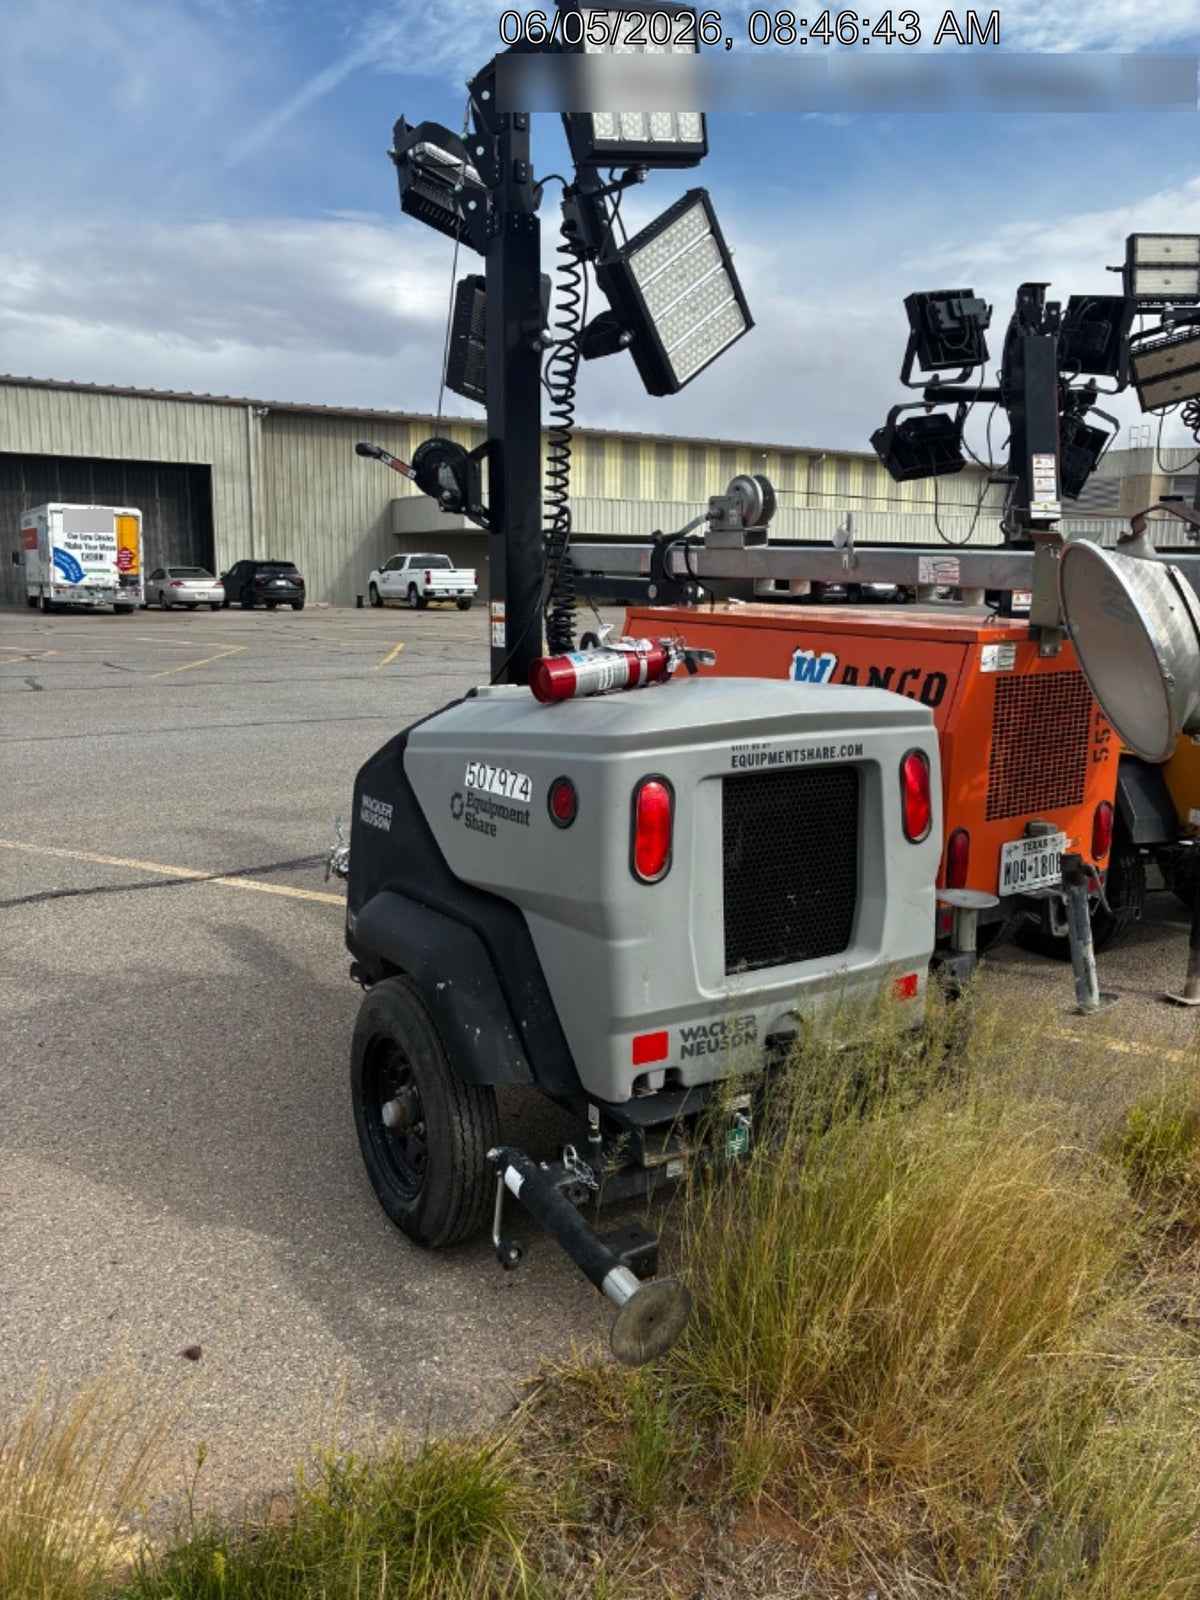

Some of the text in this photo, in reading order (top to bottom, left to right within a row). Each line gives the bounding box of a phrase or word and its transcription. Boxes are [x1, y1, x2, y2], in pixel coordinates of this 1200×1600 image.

[789, 646, 948, 708] WANCO
[731, 744, 863, 768] EQUIPMENTSHARE.COM
[466, 762, 530, 798] 507974
[465, 812, 497, 837] Share
[466, 792, 531, 827] Equipment
[1023, 839, 1048, 853] TEXAS
